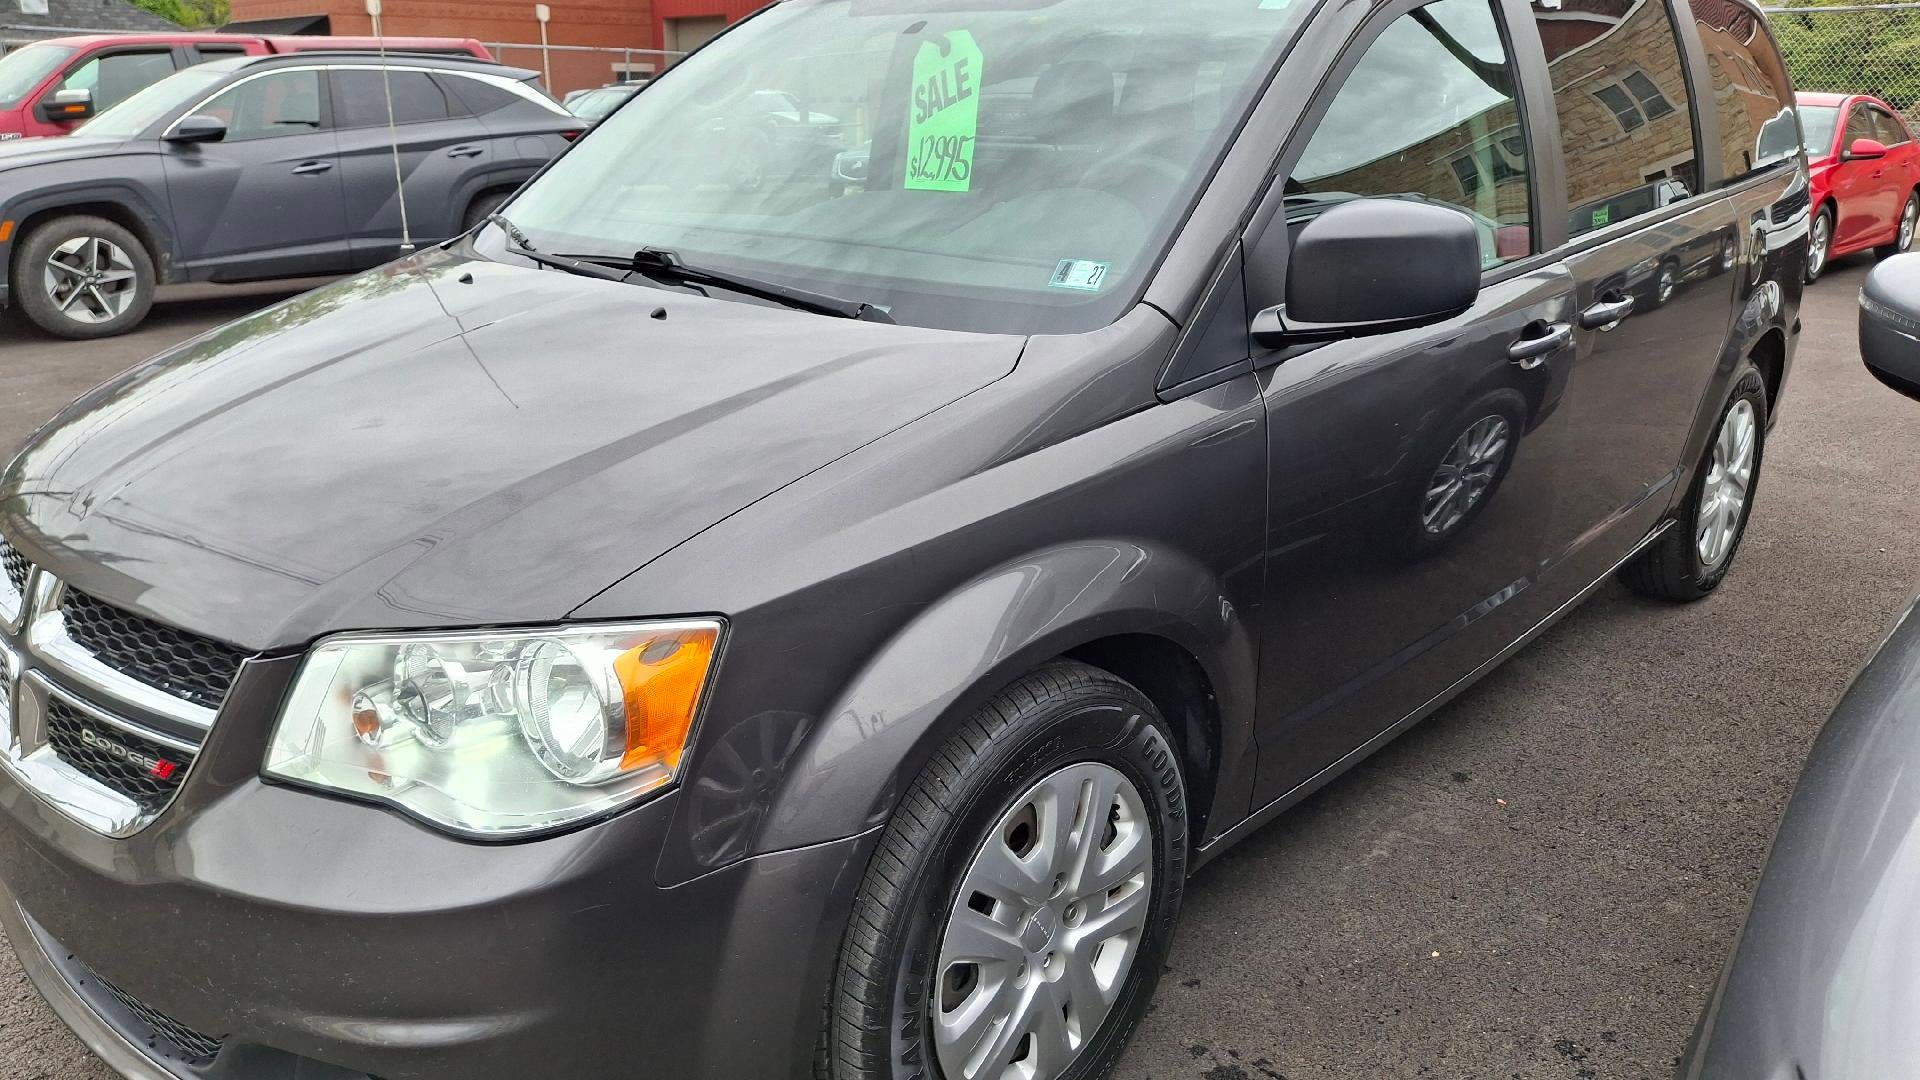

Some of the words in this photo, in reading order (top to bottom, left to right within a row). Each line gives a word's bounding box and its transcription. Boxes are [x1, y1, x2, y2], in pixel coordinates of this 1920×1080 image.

[914, 57, 972, 125] SALE
[1086, 265, 1105, 286] 27
[81, 728, 158, 773] DODGE
